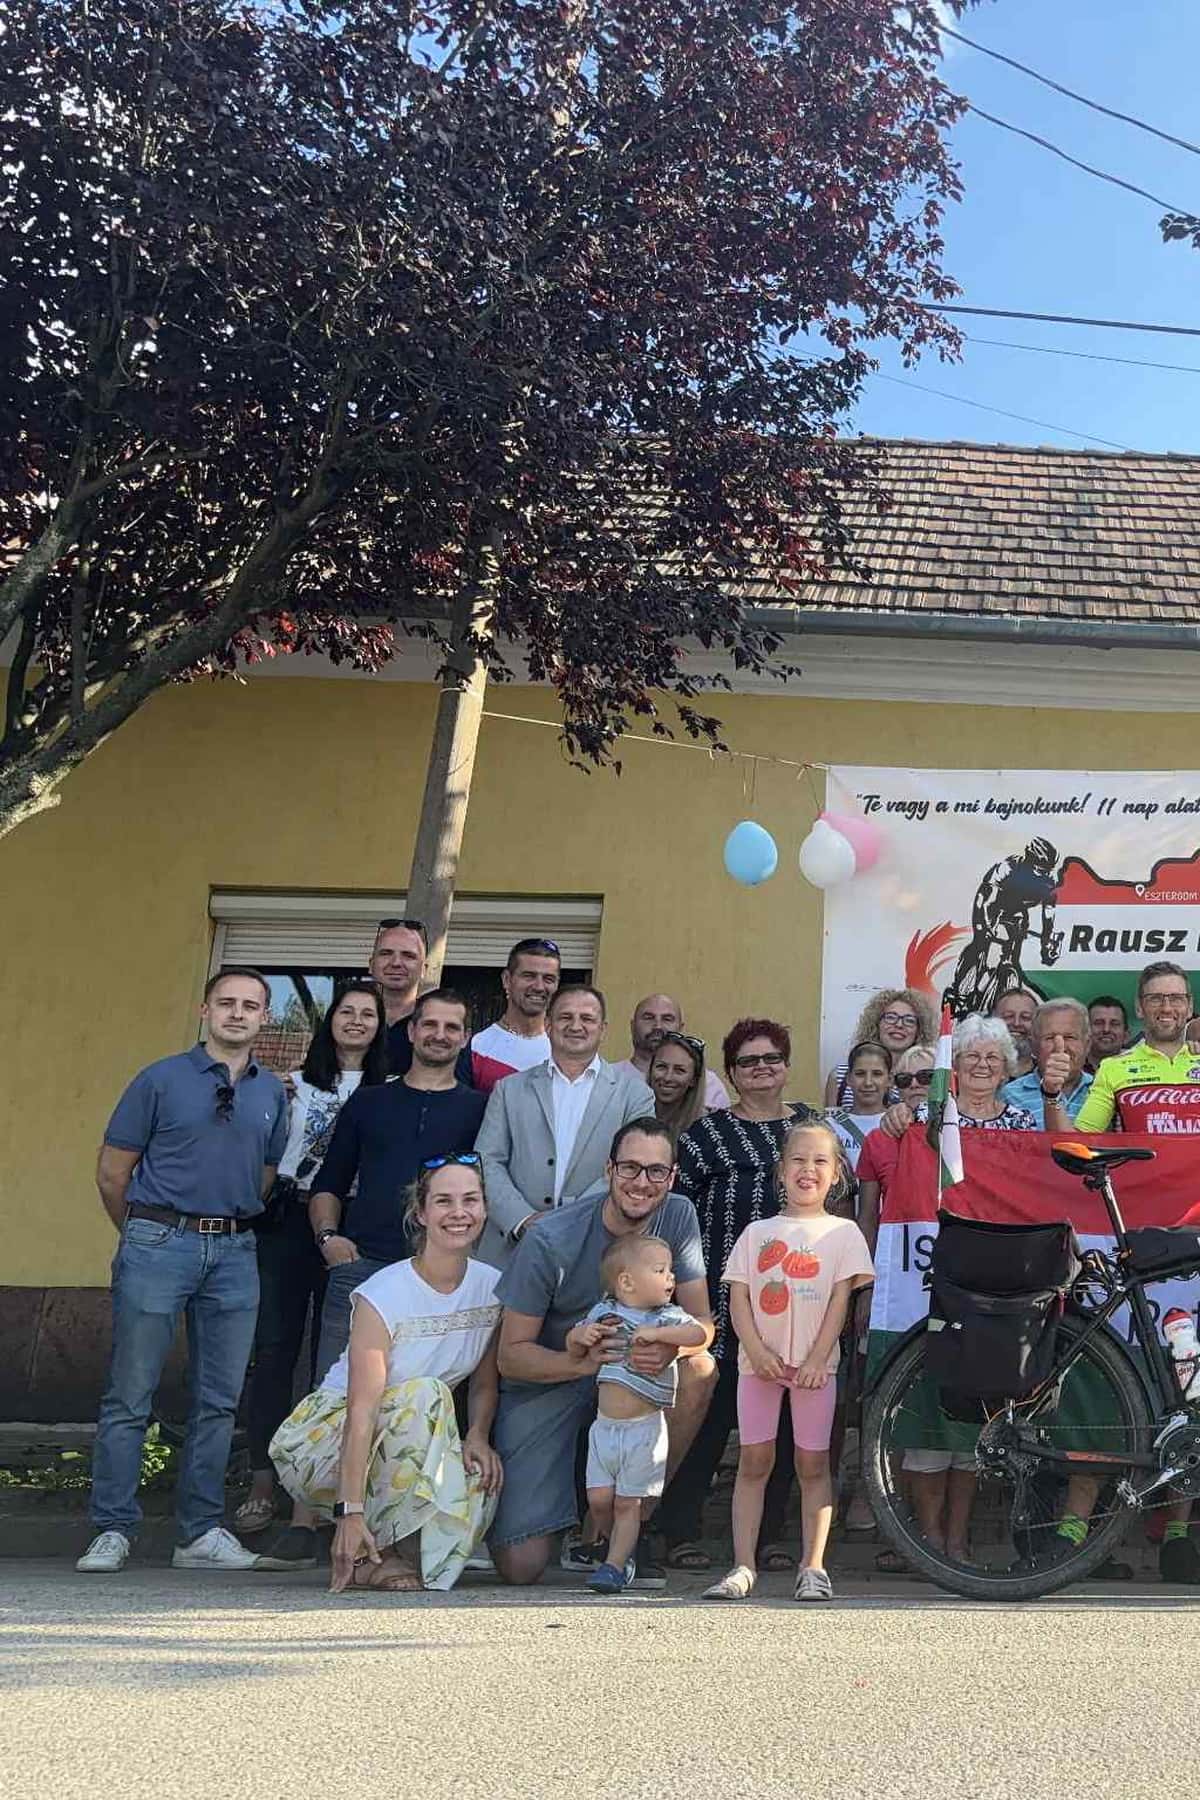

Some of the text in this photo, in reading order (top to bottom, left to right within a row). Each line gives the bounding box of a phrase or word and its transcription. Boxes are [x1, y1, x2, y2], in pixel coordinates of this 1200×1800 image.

[886, 799, 930, 821] vagy
[935, 800, 949, 813] a
[953, 799, 981, 813] mi
[983, 793, 1092, 820] bajnokunk!
[1122, 800, 1159, 820] nap
[1144, 890, 1198, 901] ESZTERGOM
[1069, 924, 1189, 953] Rausz
